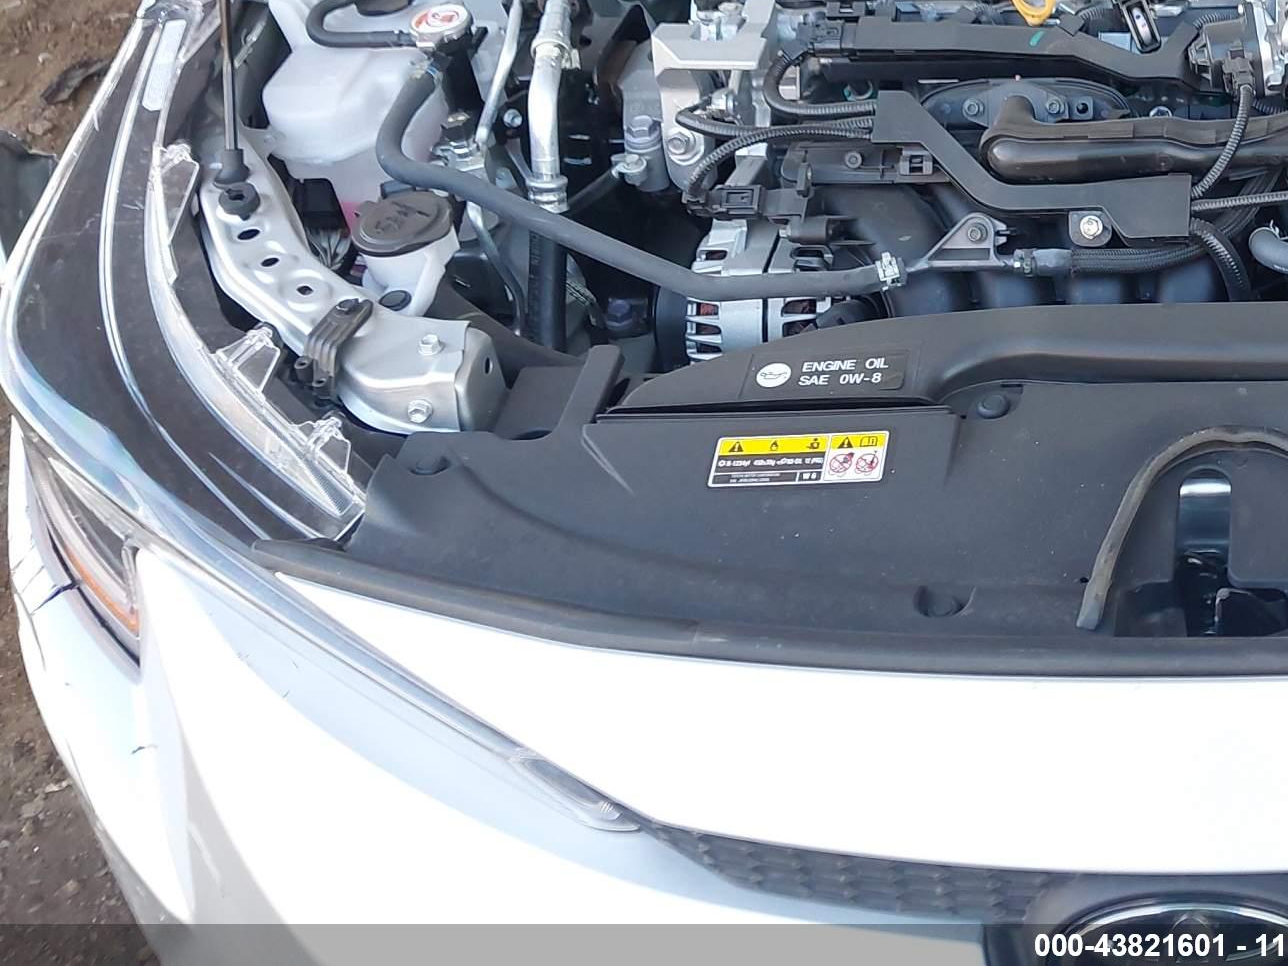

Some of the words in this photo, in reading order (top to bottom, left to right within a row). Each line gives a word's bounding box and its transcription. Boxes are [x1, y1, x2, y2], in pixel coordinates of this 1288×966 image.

[801, 359, 857, 373] ENGINE
[864, 357, 889, 370] OIL
[798, 374, 831, 386] SAE
[839, 372, 882, 385] 0W-8
